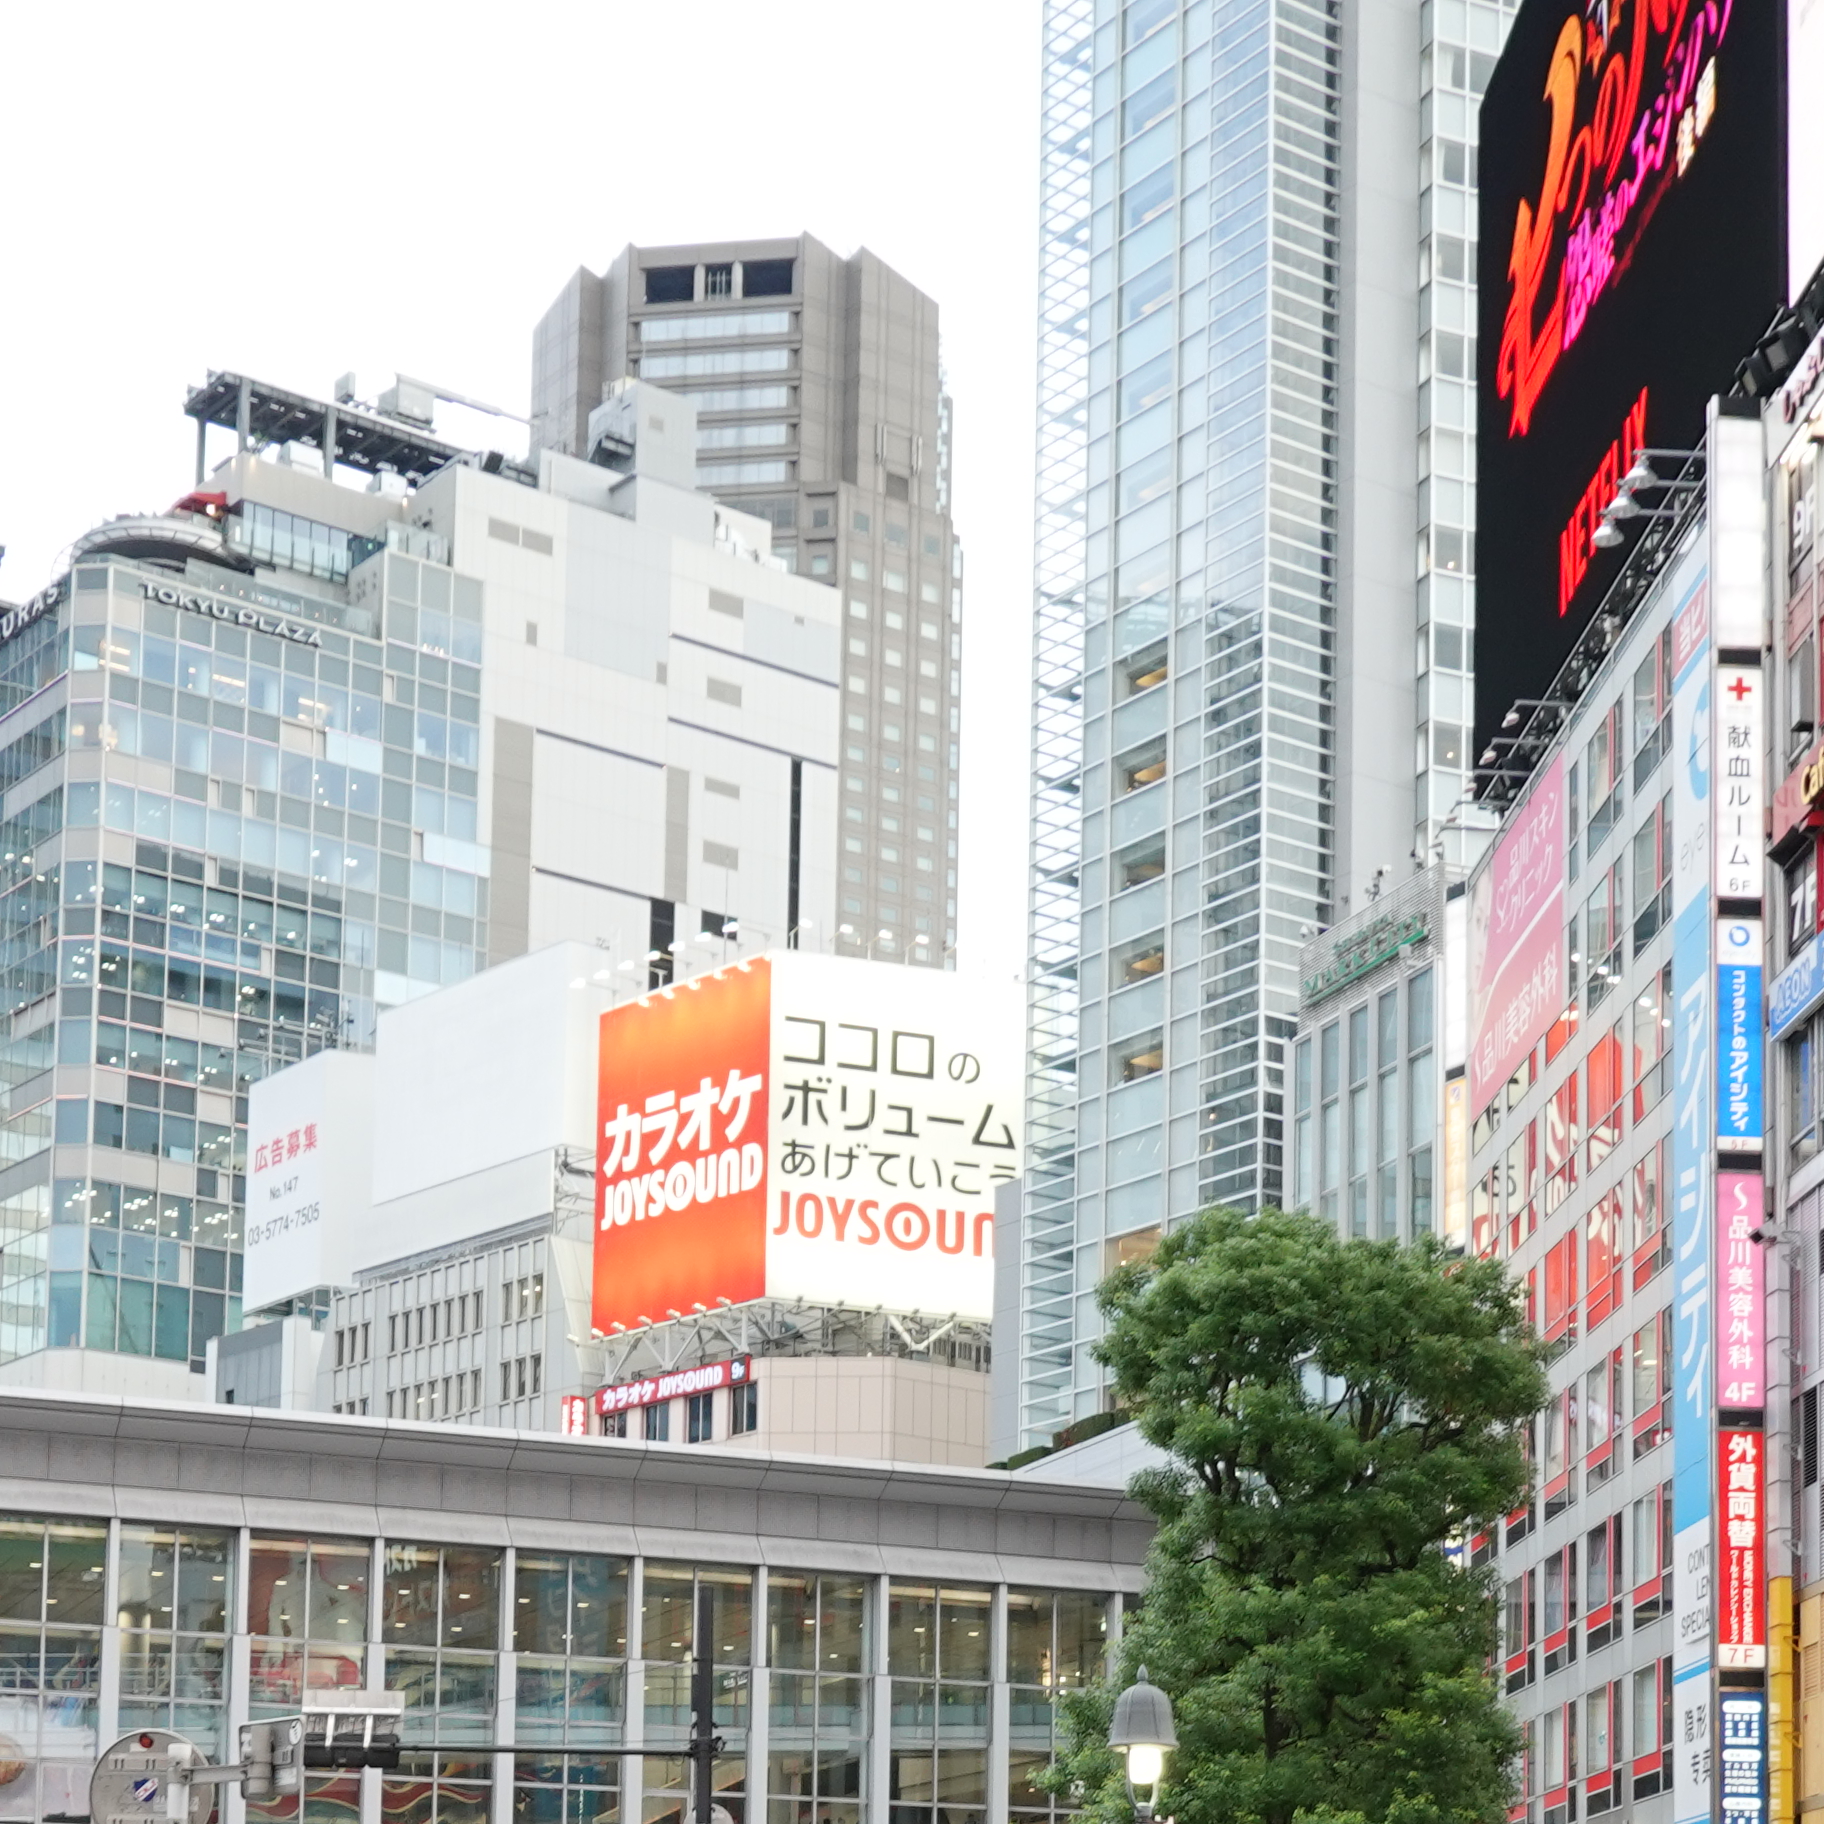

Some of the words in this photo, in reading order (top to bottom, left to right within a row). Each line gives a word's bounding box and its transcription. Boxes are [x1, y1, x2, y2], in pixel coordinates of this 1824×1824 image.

[142, 578, 229, 621] TOKYU
[238, 606, 324, 649] PLAZA
[1728, 725, 1752, 866] 献血ルーム
[1729, 878, 1751, 893] 6F
[1482, 944, 1559, 1084] 品川美容外科
[1776, 956, 1813, 1020] AEON
[783, 1015, 981, 1085] ココロの
[1731, 969, 1749, 1128] コンタクトのアイシティ
[603, 1069, 762, 1179] カラオケ
[781, 1076, 1017, 1151] ボリューム
[253, 1122, 319, 1174] 広告募集
[269, 1176, 298, 1200] No.147
[601, 1142, 764, 1231] JOYSOUND
[247, 1201, 321, 1247] 03-5774-7505
[1728, 1216, 1753, 1370] 品川美容外科
[602, 1382, 655, 1412] カラオケ
[656, 1364, 723, 1399] JOYSOUND
[1725, 1381, 1756, 1402] 4F
[1728, 1434, 1756, 1548] 外貨両替
[1742, 1550, 1753, 1585] MONEY
[1742, 1587, 1753, 1644] EXCHANGE
[1728, 1647, 1754, 1664] 7F
